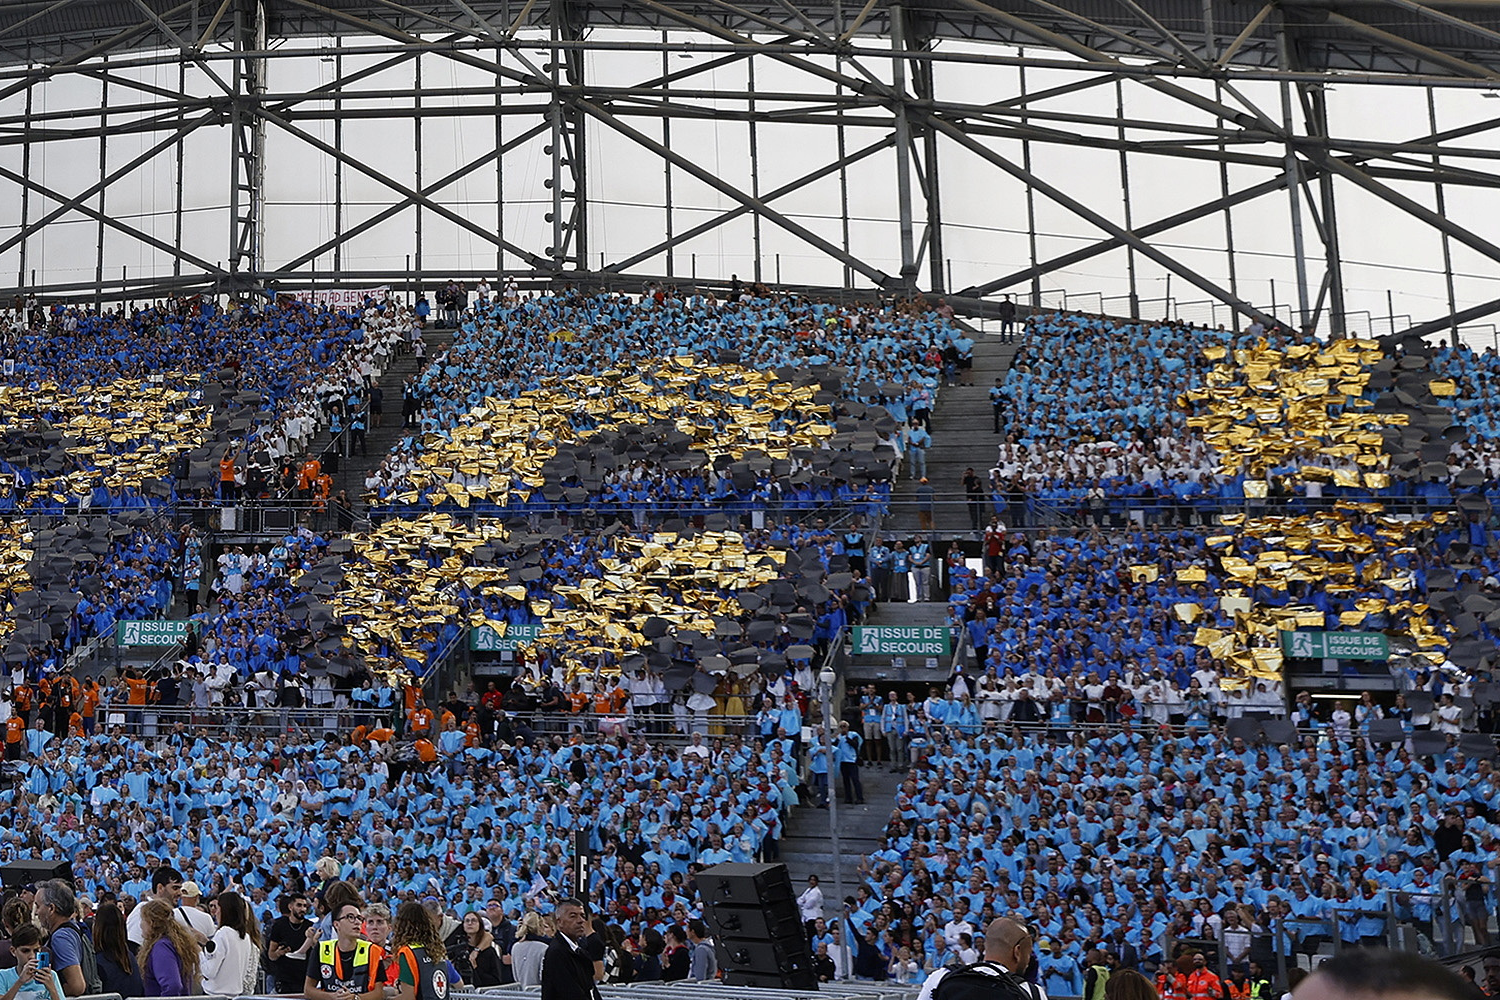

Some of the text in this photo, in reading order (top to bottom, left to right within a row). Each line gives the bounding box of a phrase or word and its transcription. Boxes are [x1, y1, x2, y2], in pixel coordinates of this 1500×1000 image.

[329, 292, 341, 303] AD
[141, 622, 188, 632] ISSUE D
[880, 627, 943, 639] ISSUE DE
[1329, 635, 1380, 645] ISSUE DE
[880, 642, 944, 653] SECOURS
[1329, 646, 1384, 656] SECOURS
[580, 855, 588, 893] F
